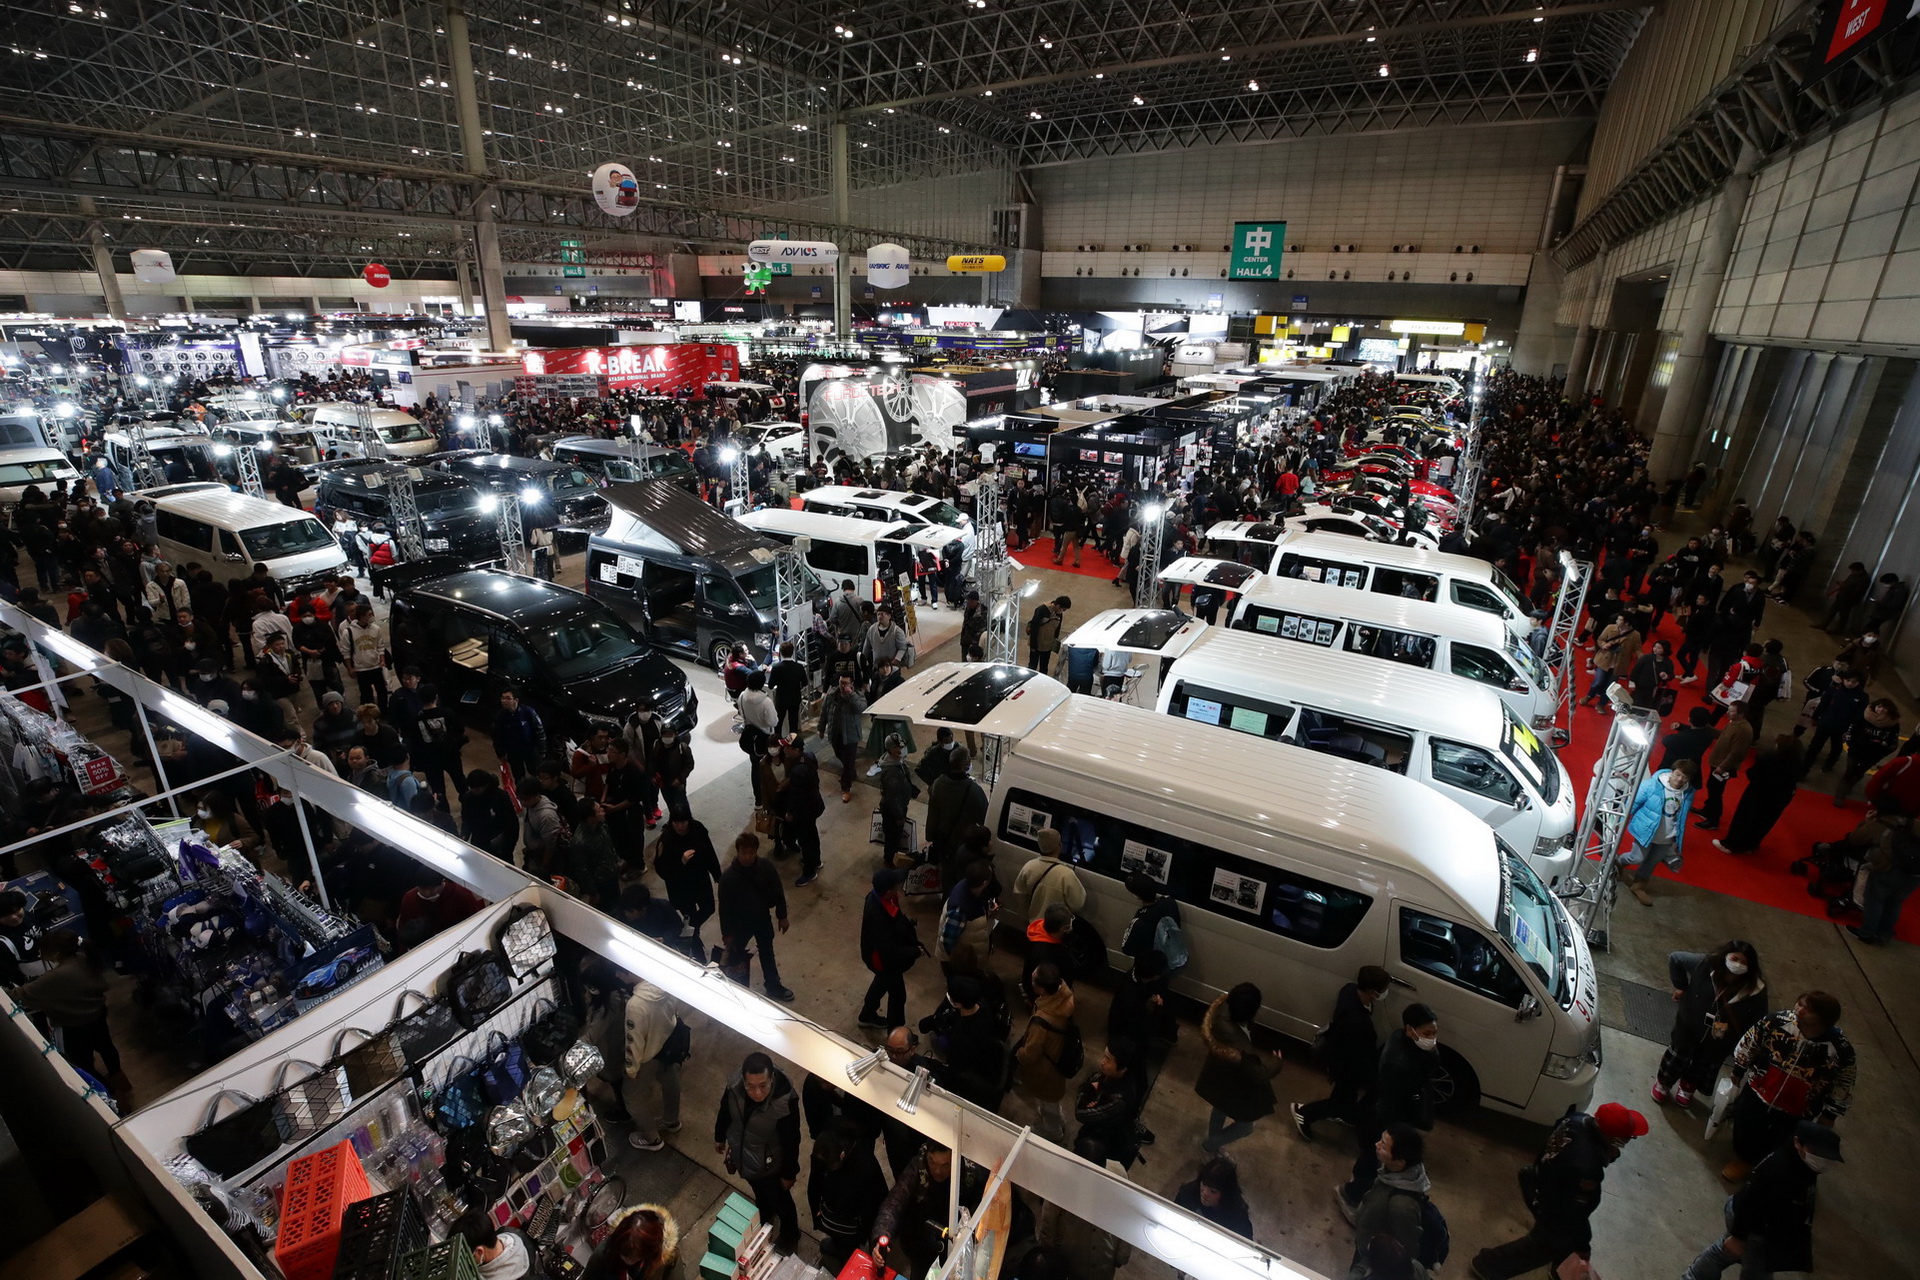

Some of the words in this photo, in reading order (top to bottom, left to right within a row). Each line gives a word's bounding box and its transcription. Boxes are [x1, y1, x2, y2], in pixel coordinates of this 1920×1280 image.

[1844, 6, 1871, 39] WEST
[1245, 227, 1272, 256] 中
[781, 264, 787, 273] 5
[1236, 268, 1261, 277] HALL
[1262, 265, 1273, 277] 4
[913, 336, 938, 346] NATS
[90, 761, 107, 769] MAX
[95, 772, 109, 781] OFF
[95, 783, 116, 795] SALE
[356, 952, 382, 973] 2020
